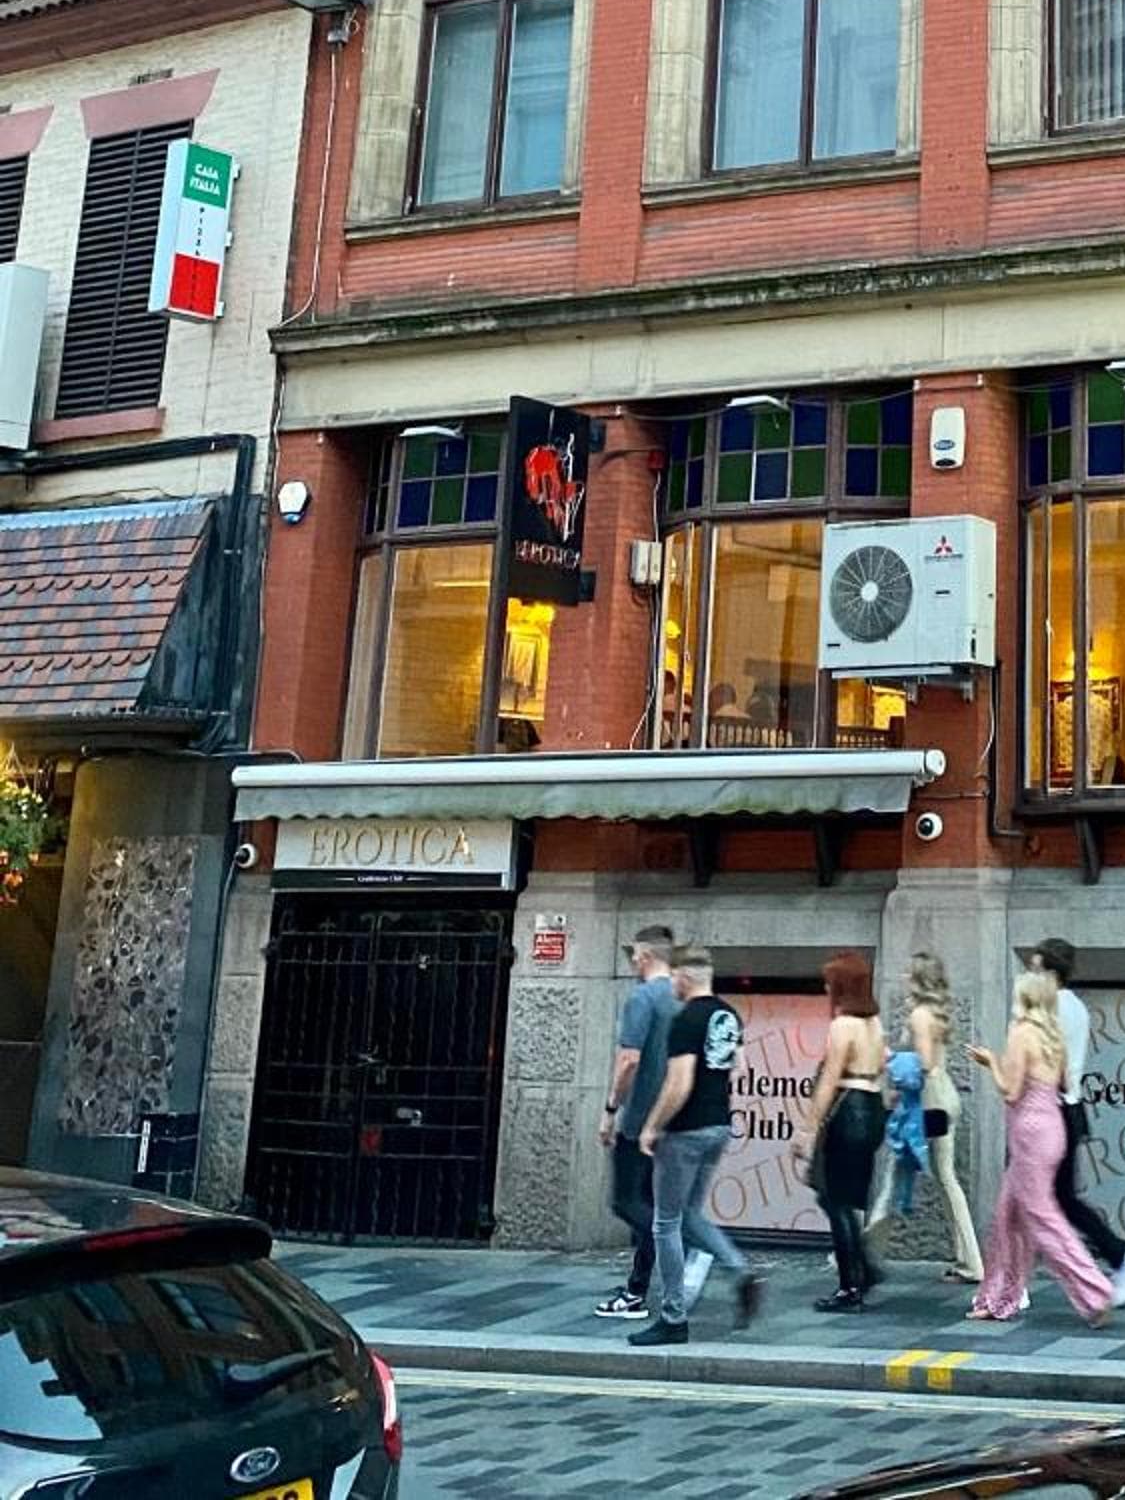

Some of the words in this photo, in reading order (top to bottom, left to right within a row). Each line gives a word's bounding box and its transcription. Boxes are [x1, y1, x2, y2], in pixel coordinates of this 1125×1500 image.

[194, 162, 220, 180] CASA
[308, 826, 475, 867] EROTICA
[729, 1109, 795, 1141] Club
